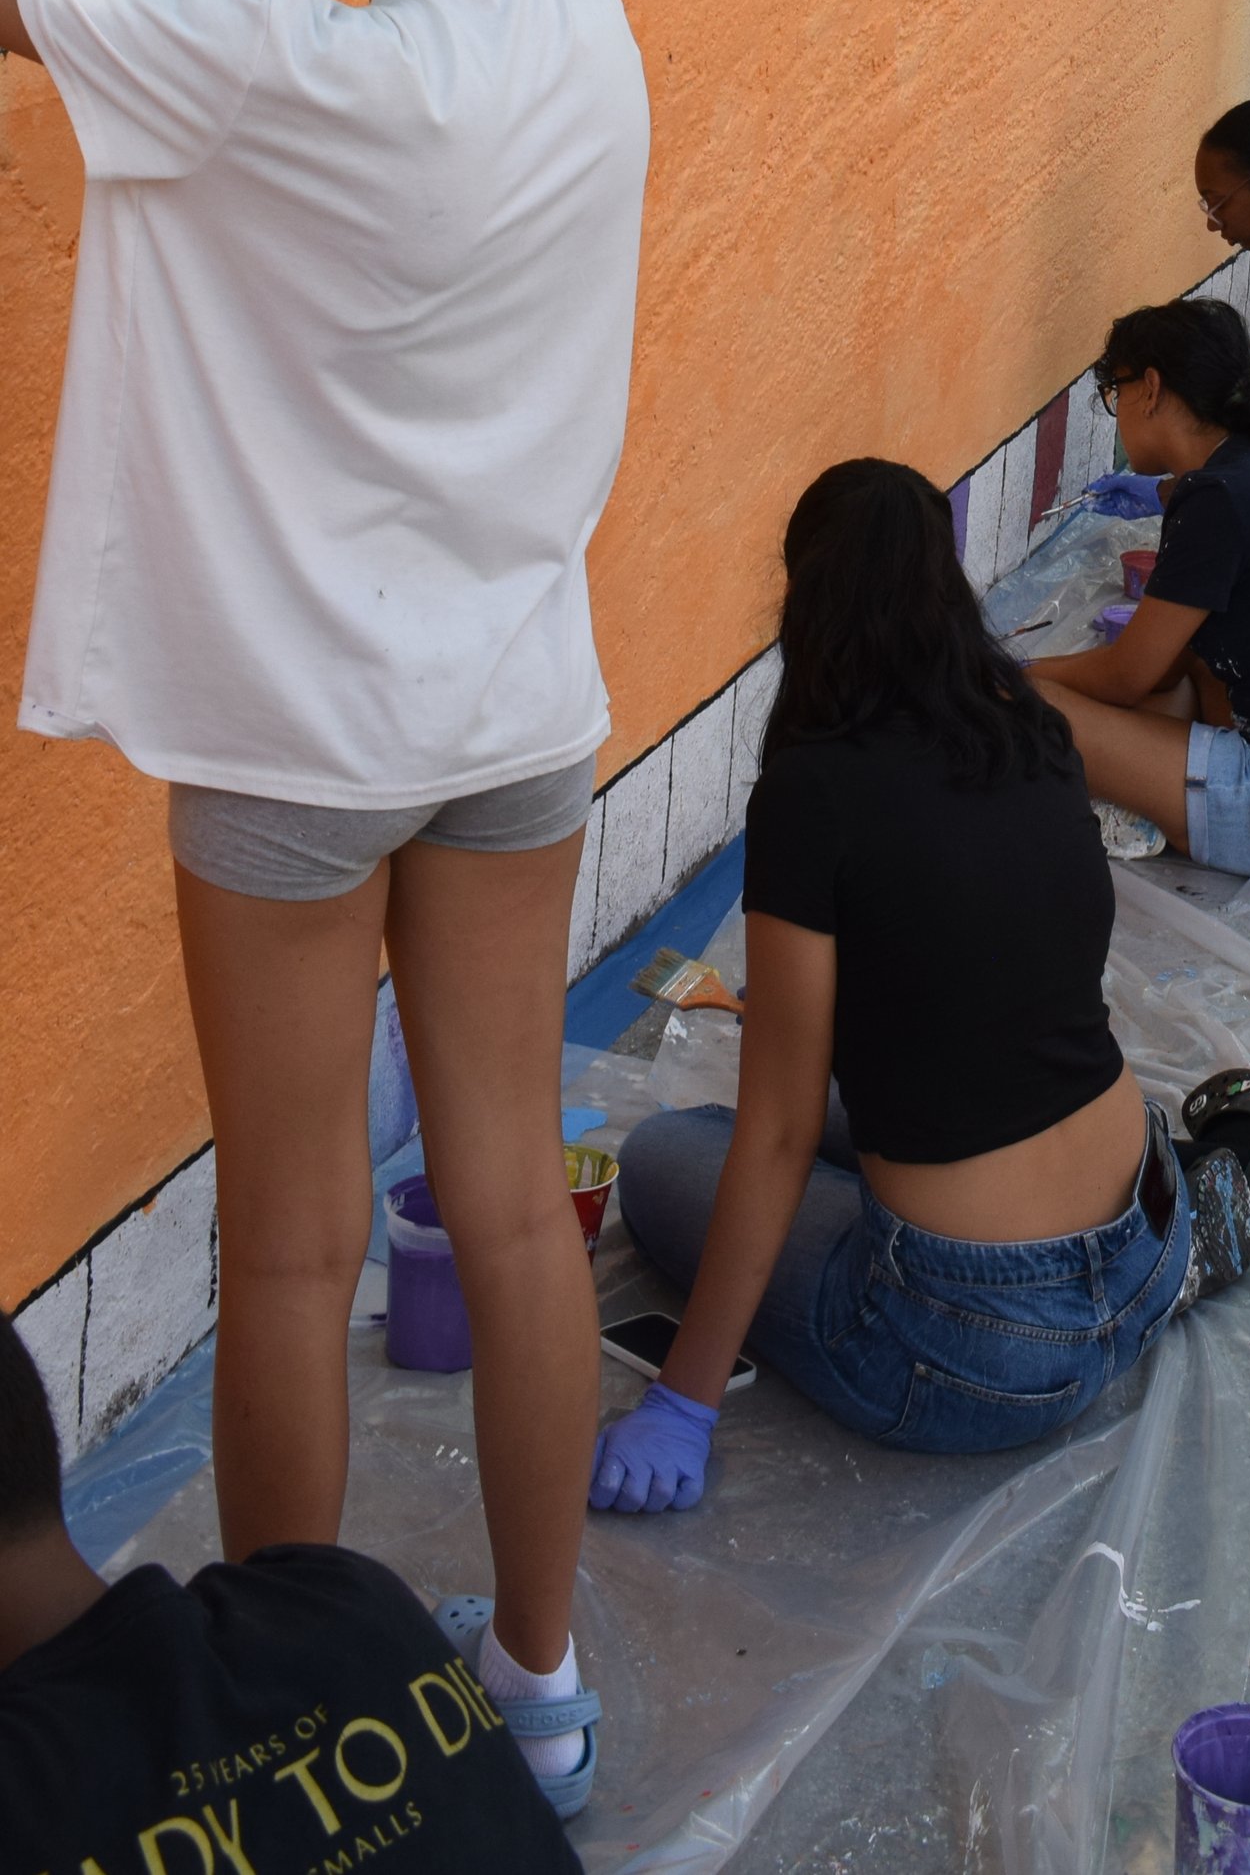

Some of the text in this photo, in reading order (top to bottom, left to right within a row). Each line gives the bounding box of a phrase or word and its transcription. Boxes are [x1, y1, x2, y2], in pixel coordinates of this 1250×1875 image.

[170, 1704, 327, 1796] 25 YEARS OF
[274, 1717, 408, 1836] TO
